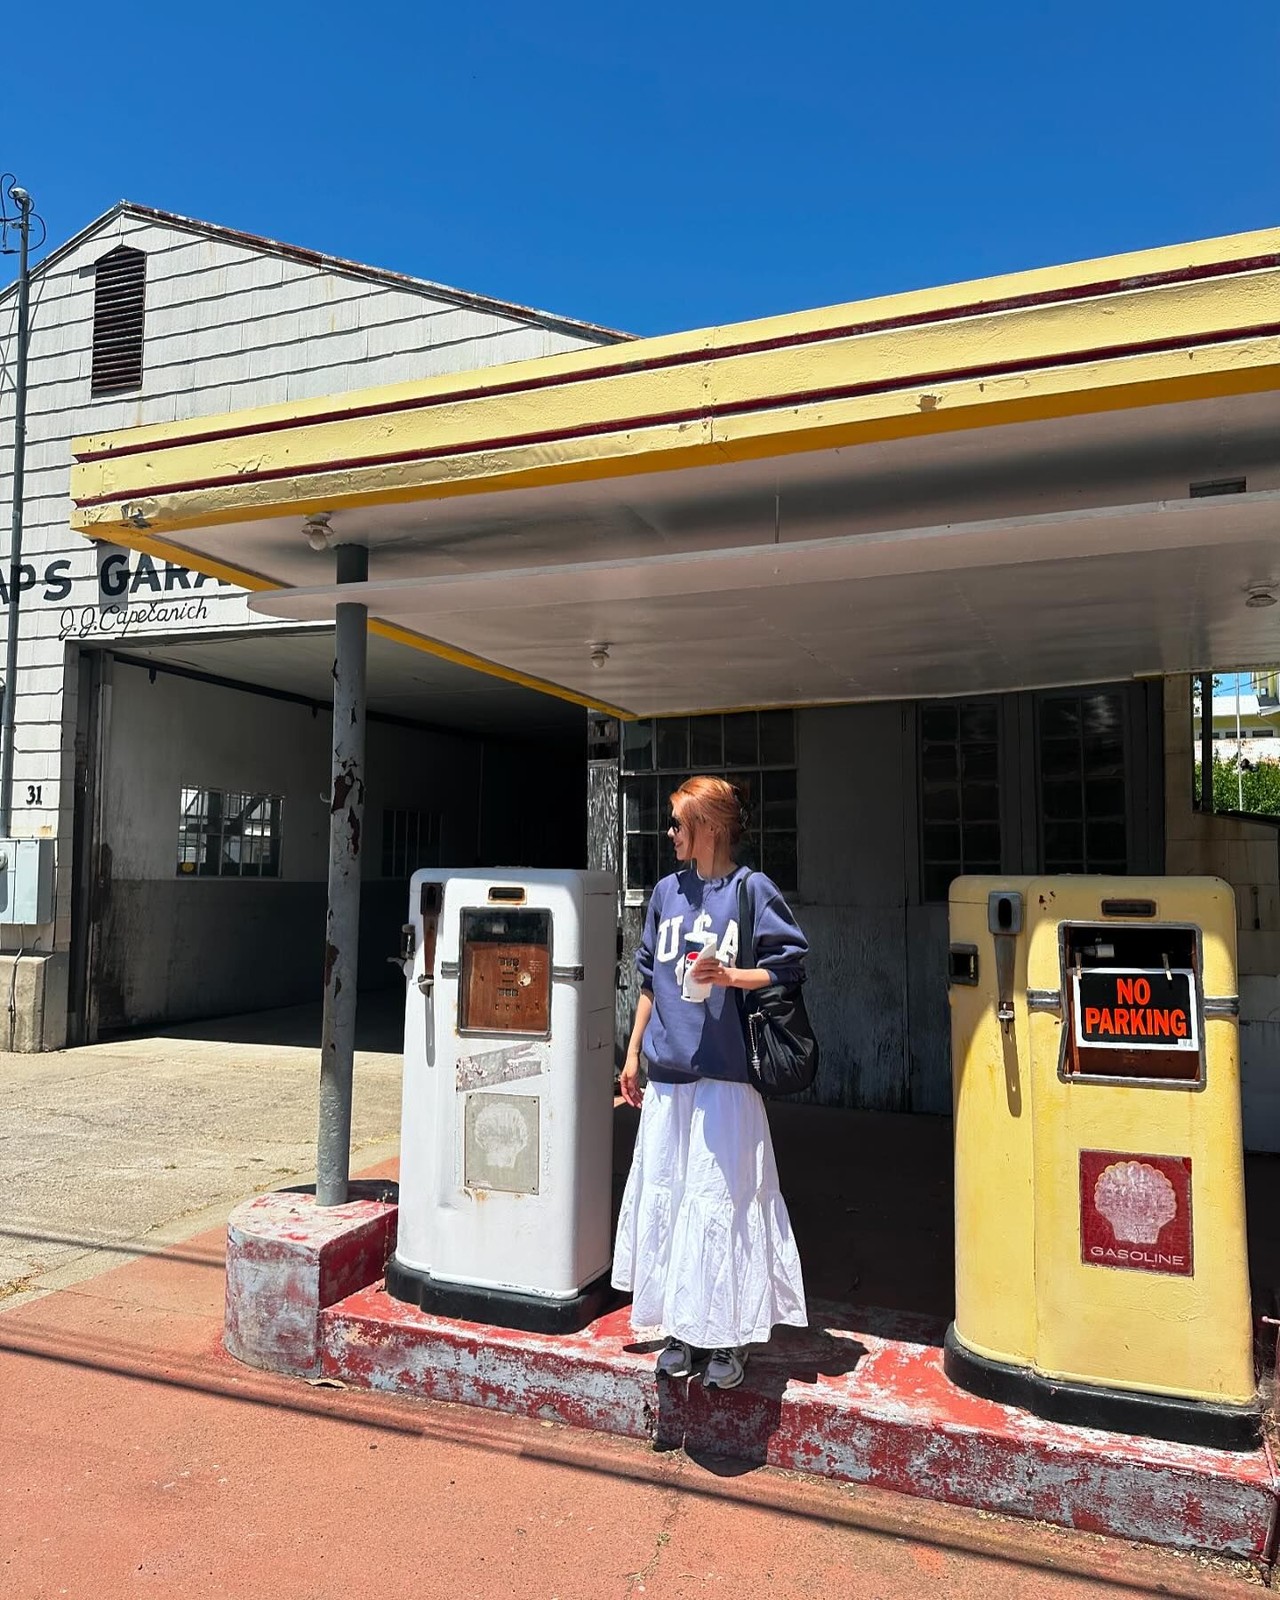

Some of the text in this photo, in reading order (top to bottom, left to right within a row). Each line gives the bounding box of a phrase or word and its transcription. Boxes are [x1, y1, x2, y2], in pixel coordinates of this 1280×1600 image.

[26, 784, 43, 806] 31
[1116, 977, 1151, 1006] NO
[1085, 1007, 1187, 1037] PARKING
[1090, 1246, 1185, 1266] GASOLINE
